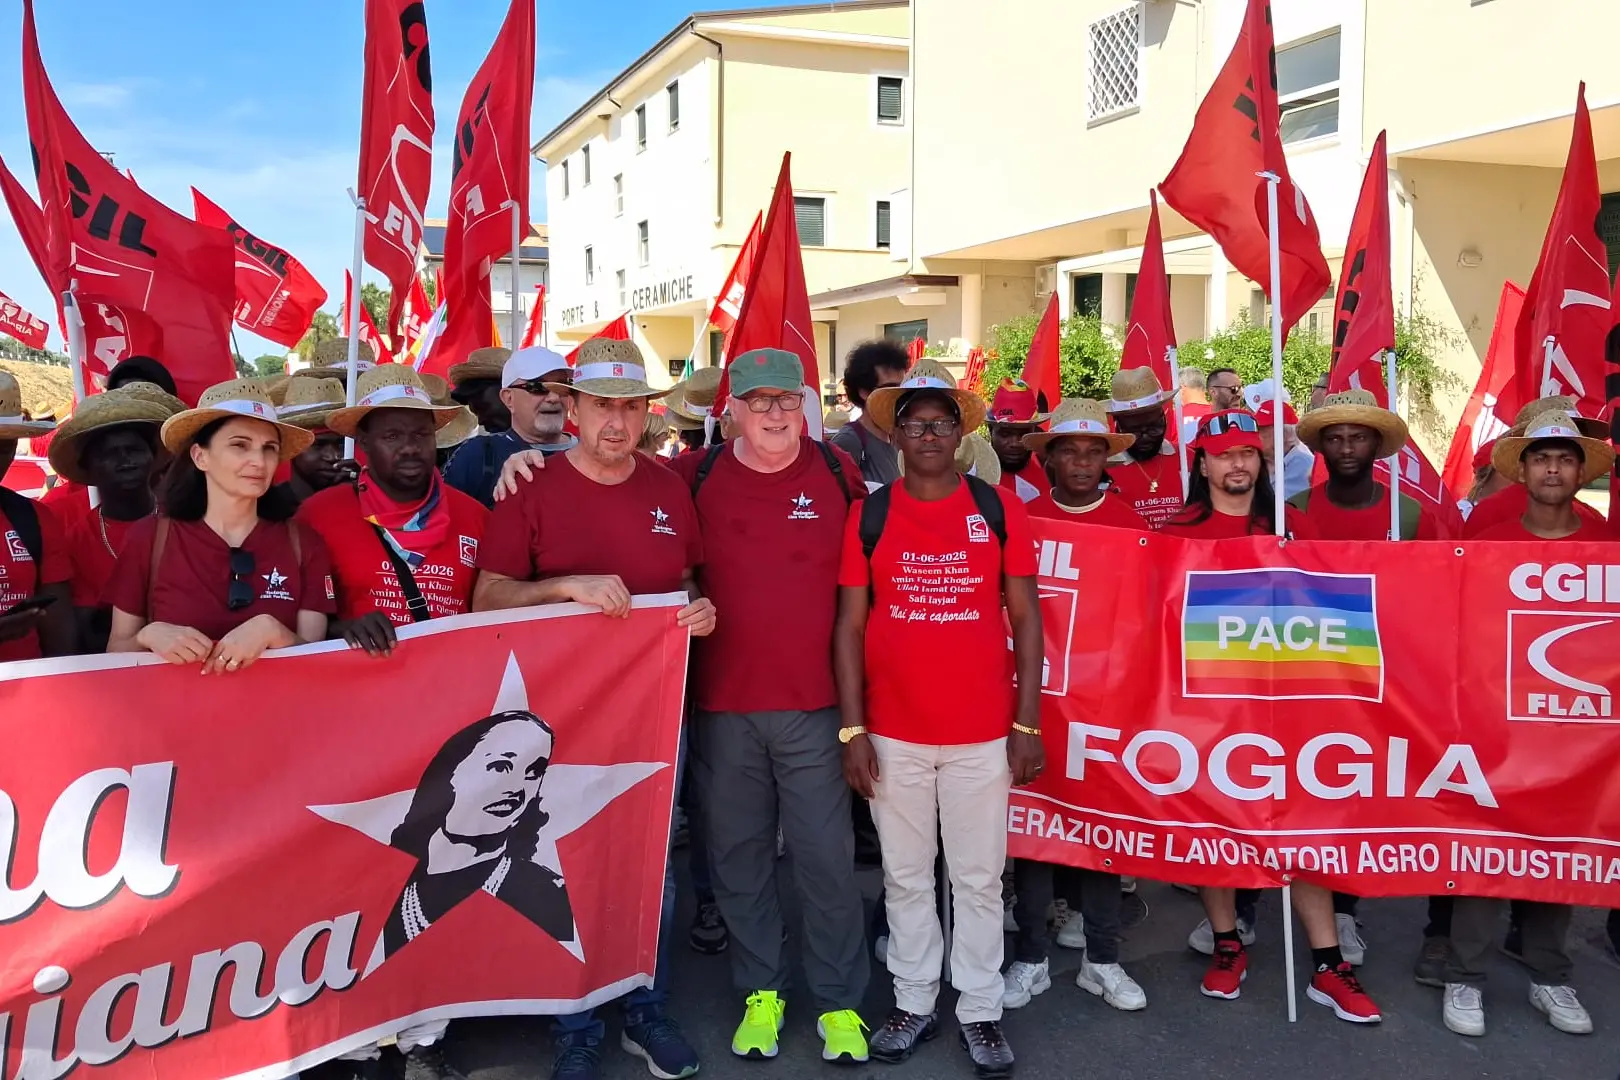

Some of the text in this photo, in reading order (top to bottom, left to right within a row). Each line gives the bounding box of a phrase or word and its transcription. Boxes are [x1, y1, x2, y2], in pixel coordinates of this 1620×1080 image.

[64, 160, 157, 259] GIL
[562, 305, 584, 326] PORTE
[632, 275, 693, 310] CERAMICHE
[0, 296, 44, 331] GIL
[1135, 497, 1180, 507] 01-06-2026
[902, 550, 967, 562] 01-06-2026
[1034, 539, 1080, 580] IL
[902, 566, 970, 575] Waseem Khan
[943, 575, 983, 585] Khogjani
[368, 588, 396, 598] Amin
[428, 581, 453, 592] Khan
[374, 599, 402, 609] Ullah
[908, 594, 926, 603] Safi
[389, 612, 411, 623] Safi
[889, 604, 979, 624] Mai più caporalato
[1217, 615, 1348, 653] PACE
[1528, 693, 1612, 717] FLAI
[1065, 721, 1500, 809] FOGGIA
[1007, 805, 1155, 858] ERAZIONE
[1165, 833, 1348, 875] LAVORATORI
[1357, 841, 1440, 875] AGRO
[0, 911, 362, 1080] iana
